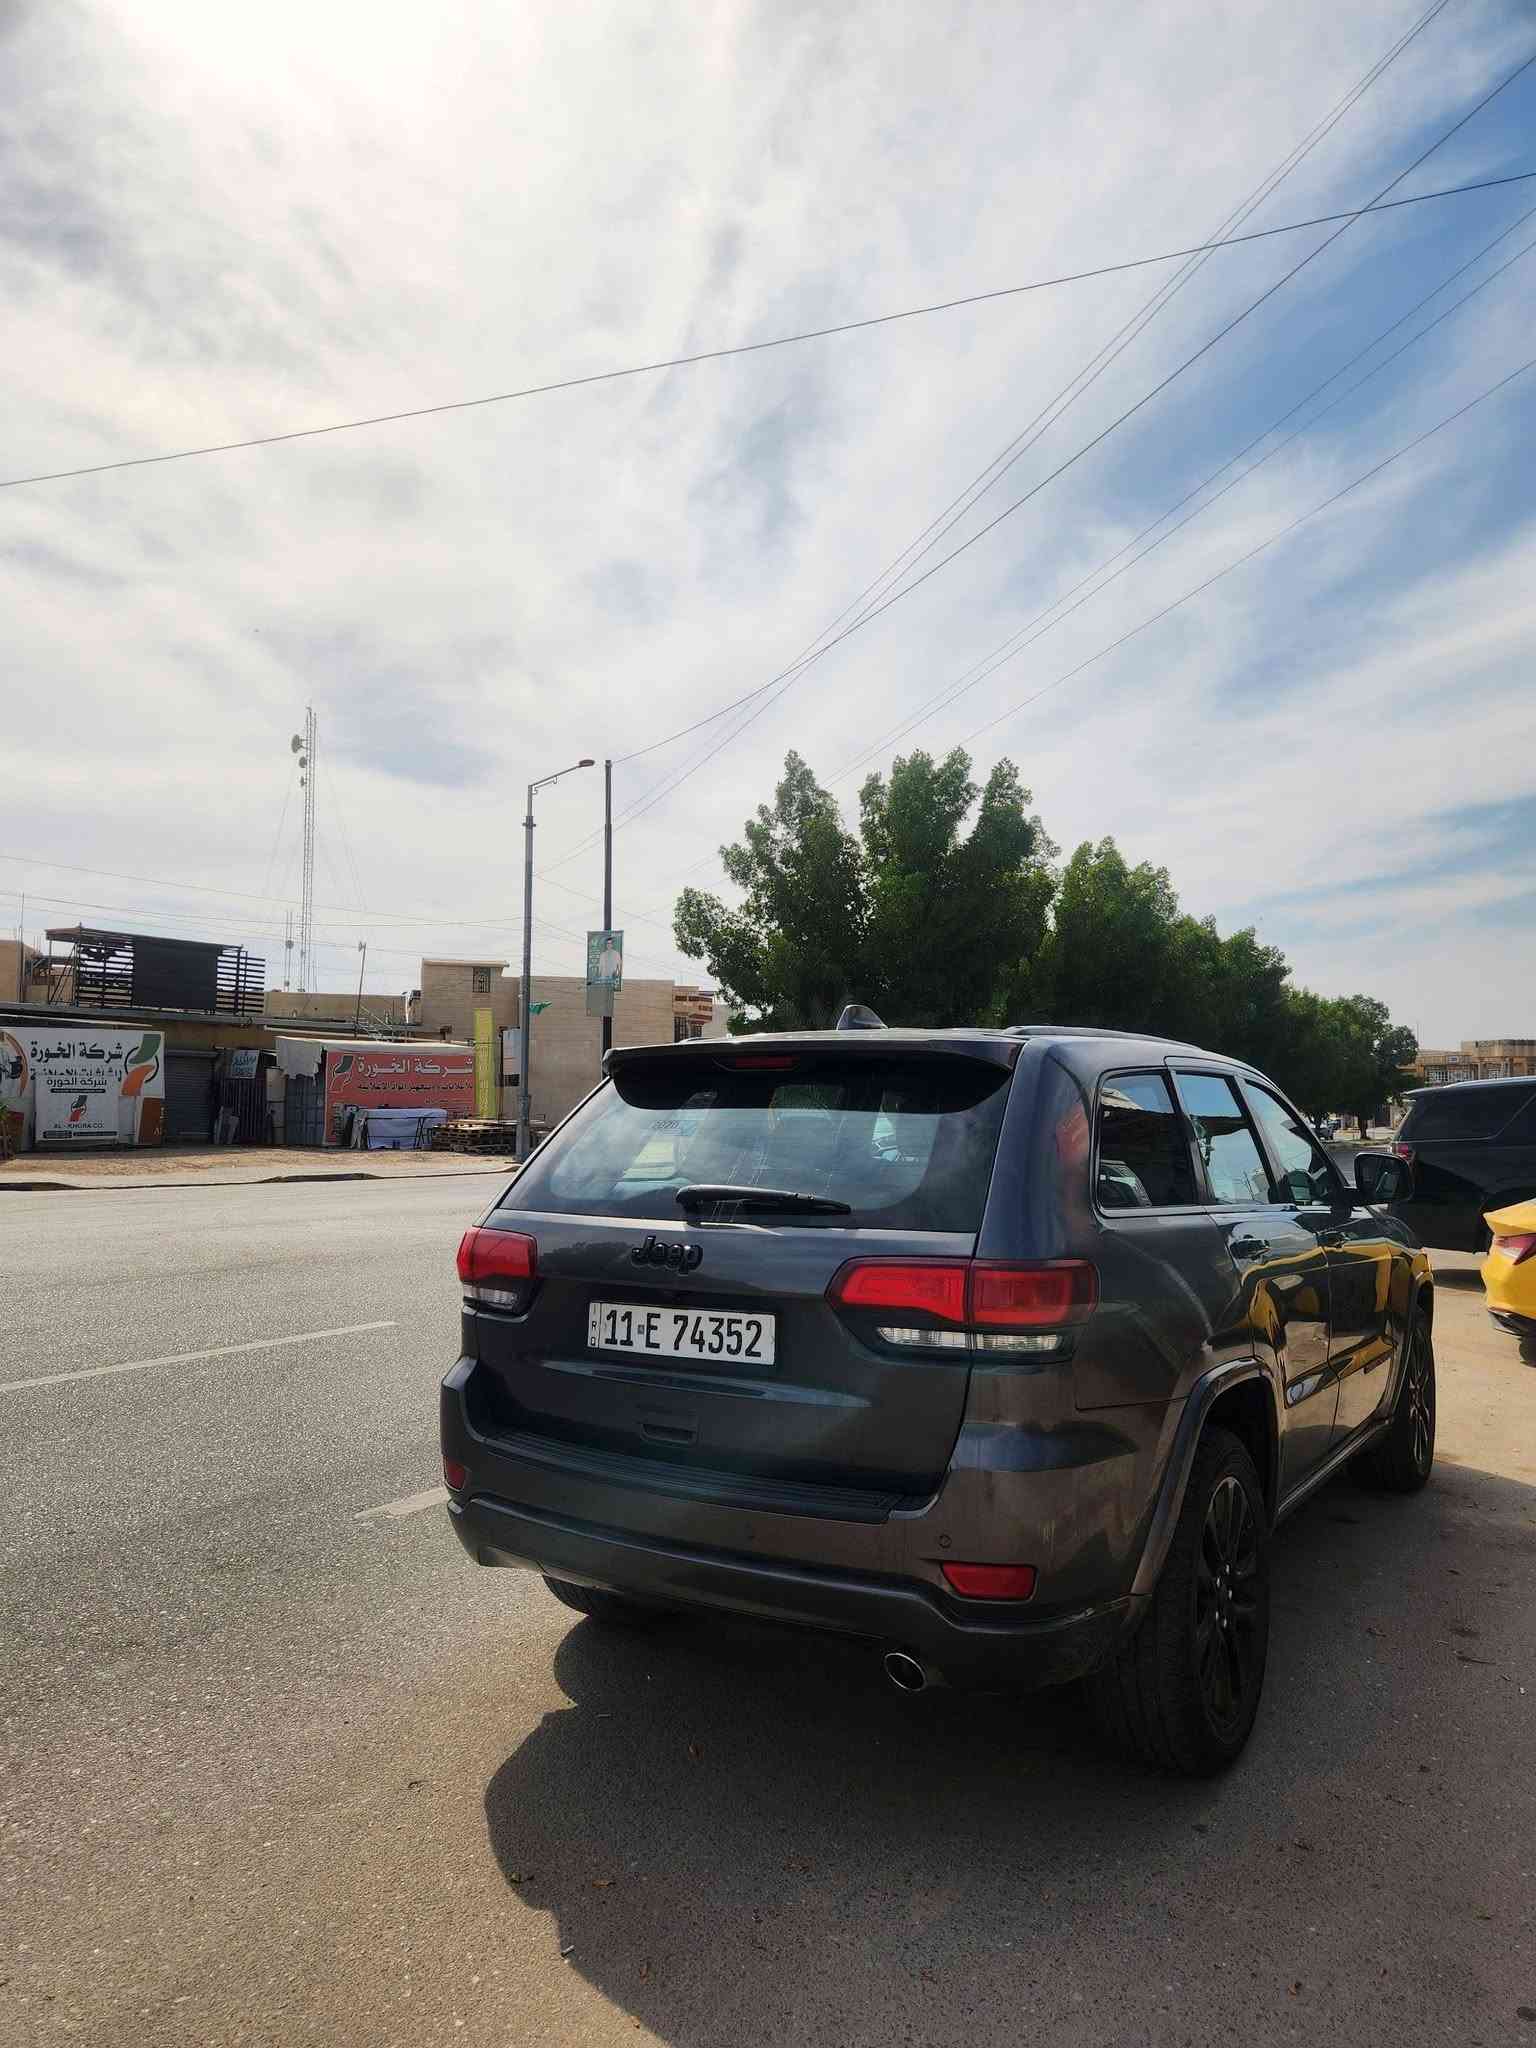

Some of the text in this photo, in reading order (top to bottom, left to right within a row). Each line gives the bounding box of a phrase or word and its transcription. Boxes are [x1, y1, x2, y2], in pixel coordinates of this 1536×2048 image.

[30, 1041, 122, 1063] شركة الخورة
[358, 1057, 473, 1077] شركة الخورة
[631, 1235, 703, 1276] Jeep
[604, 1310, 763, 1358] 11 E 74352
